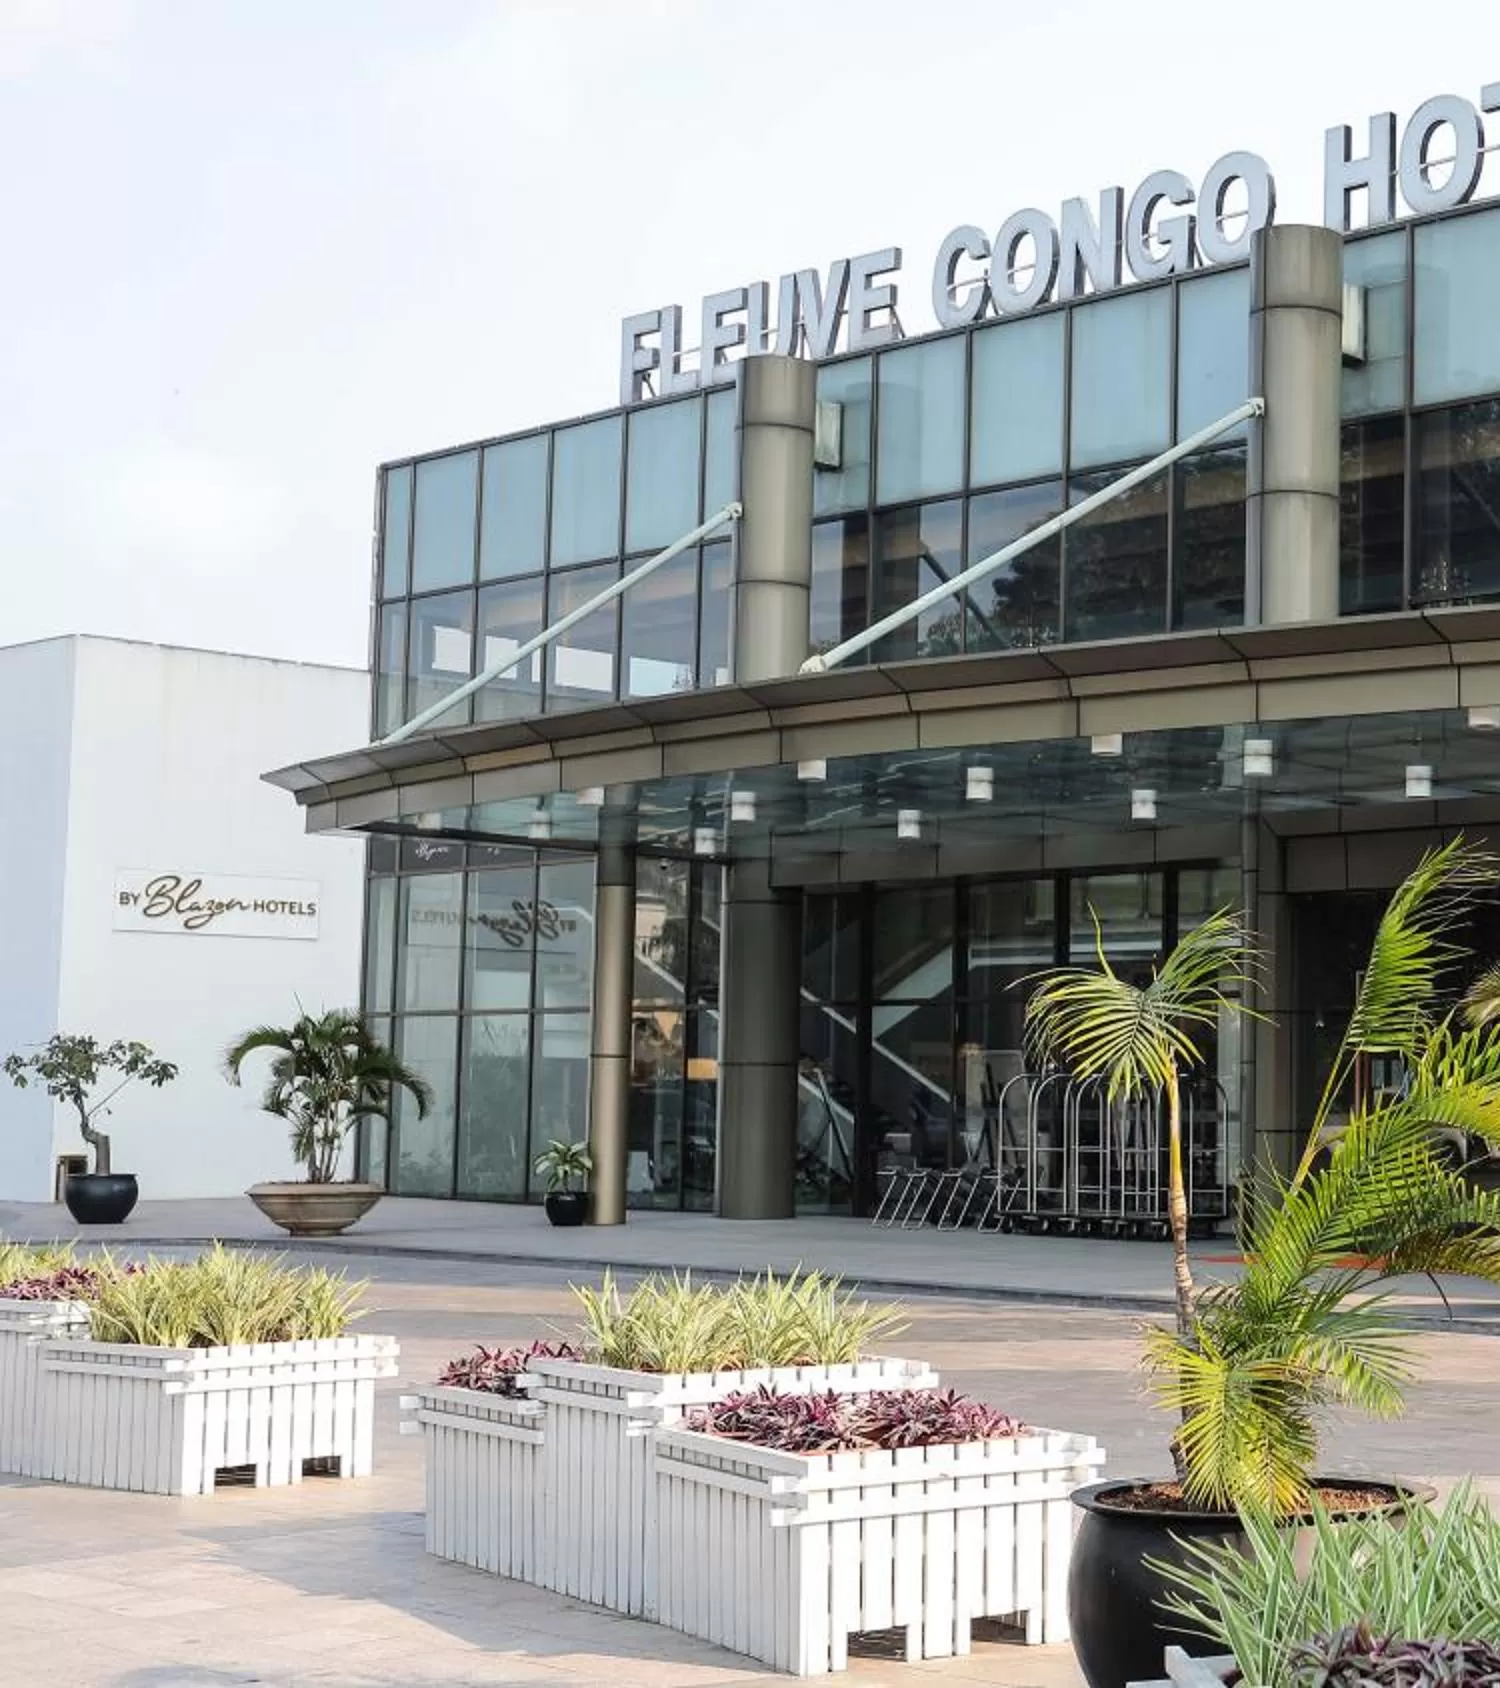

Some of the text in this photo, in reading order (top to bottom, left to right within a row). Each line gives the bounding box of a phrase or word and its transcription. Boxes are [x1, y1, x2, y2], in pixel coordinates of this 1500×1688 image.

[621, 247, 904, 405] FLEUVE
[932, 150, 1276, 329] CONGO
[118, 891, 141, 906] BY
[252, 901, 317, 916] HOTELS
